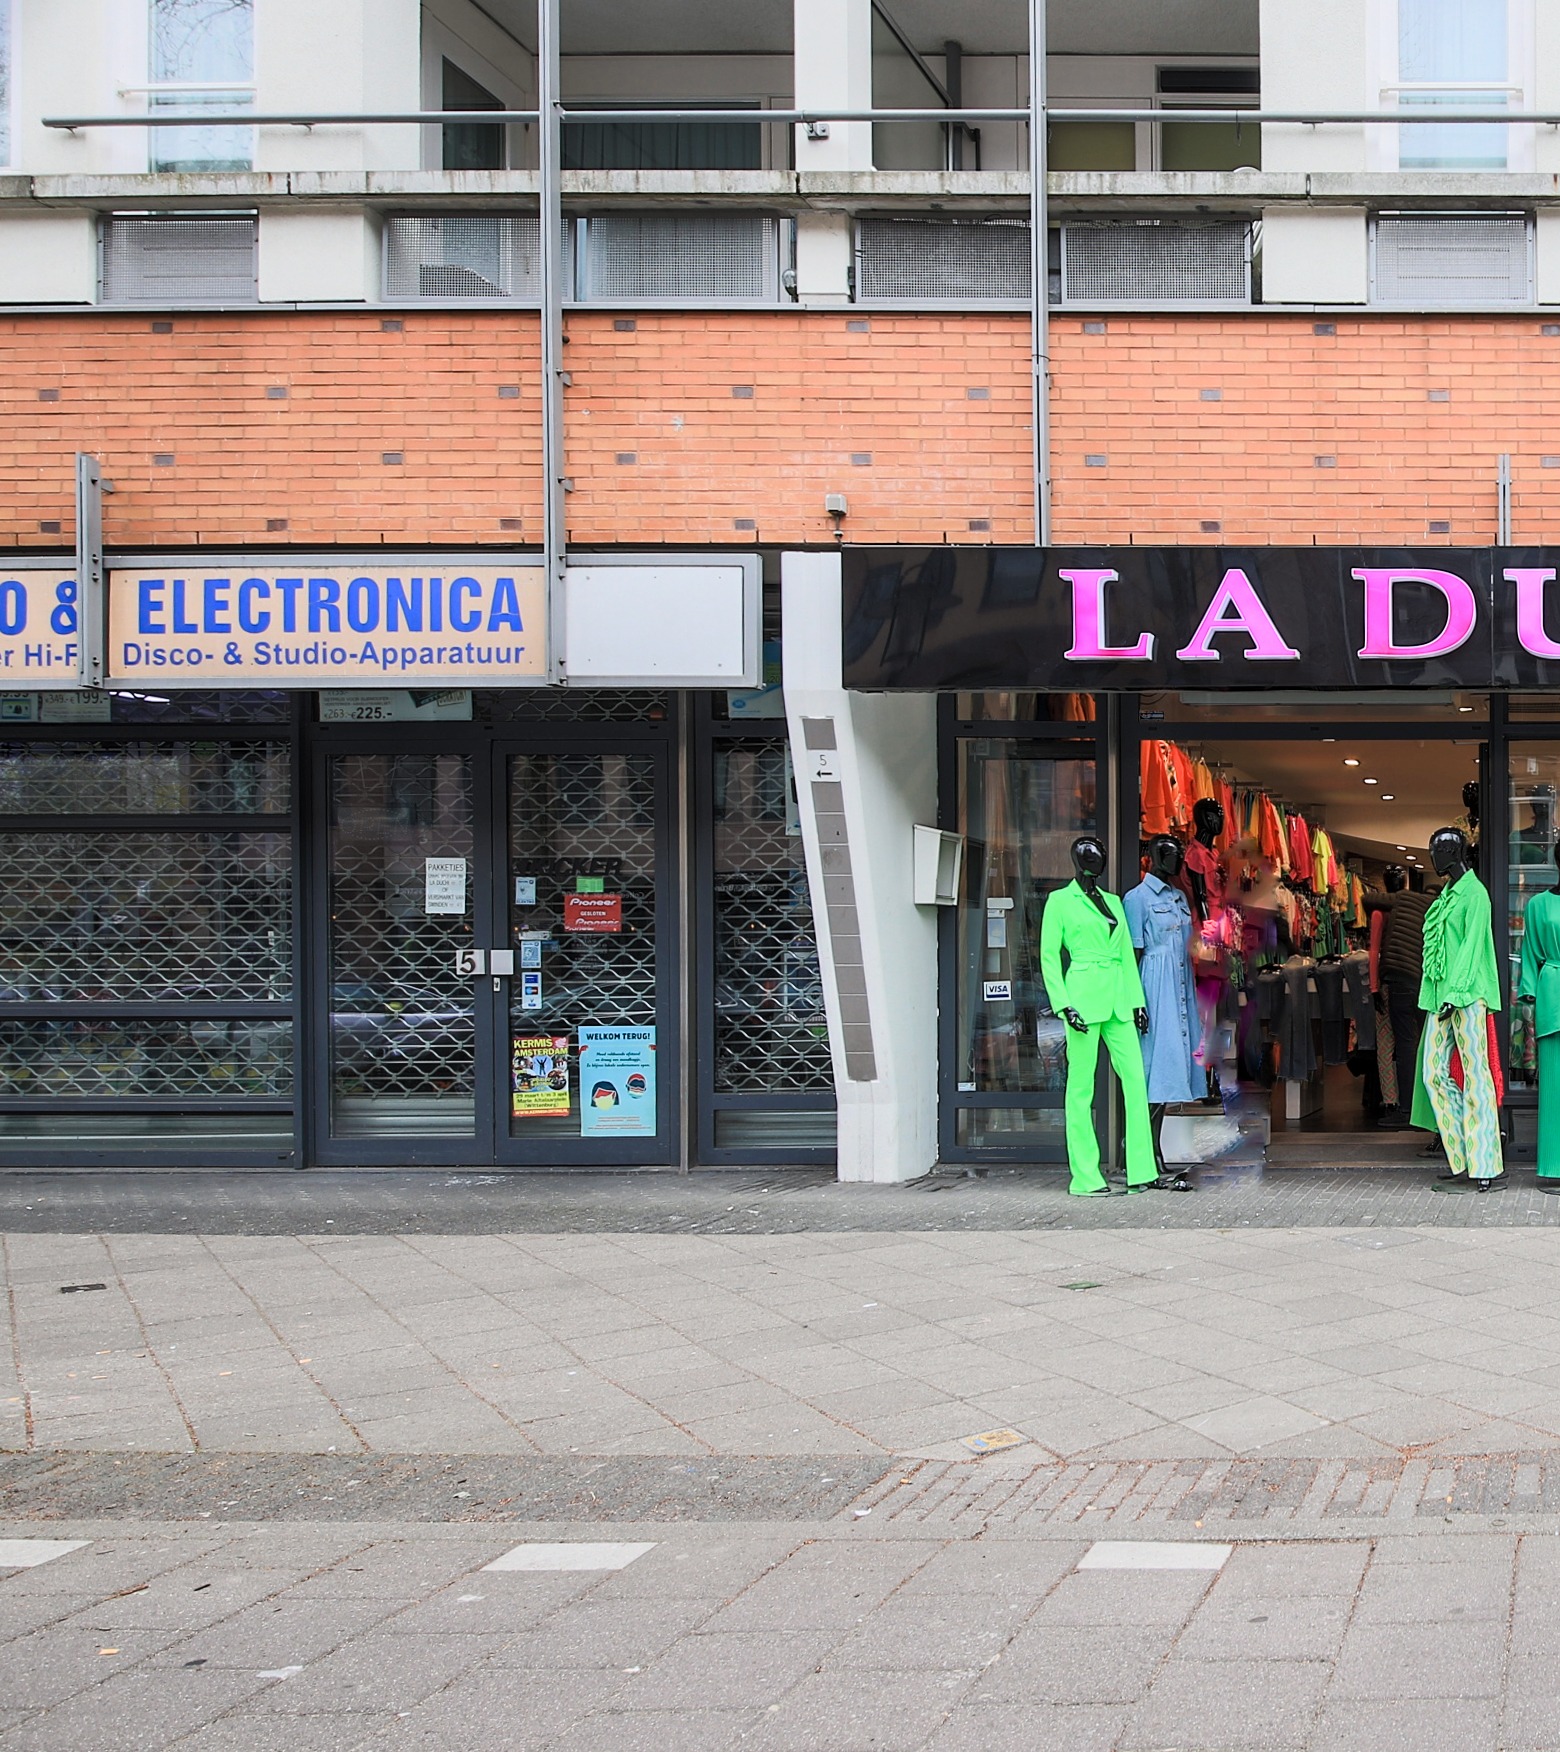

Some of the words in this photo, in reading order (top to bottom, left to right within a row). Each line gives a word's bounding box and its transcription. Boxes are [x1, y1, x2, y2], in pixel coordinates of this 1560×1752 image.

[0, 580, 27, 636] O
[138, 577, 524, 634] ELECTRONICA
[1058, 567, 1300, 661] LA
[25, 644, 77, 667] Hi-F
[124, 643, 214, 666] Disco-
[223, 641, 243, 666] &
[254, 641, 525, 670] Studio-Apparatuur
[819, 755, 827, 766] 5
[428, 864, 464, 872] PAKKETJES
[570, 897, 617, 906] Pioneer
[460, 951, 476, 973] 5
[988, 985, 1008, 993] VISA
[514, 1039, 553, 1048] KERMIS
[514, 1048, 568, 1057] AMSTERDAM
